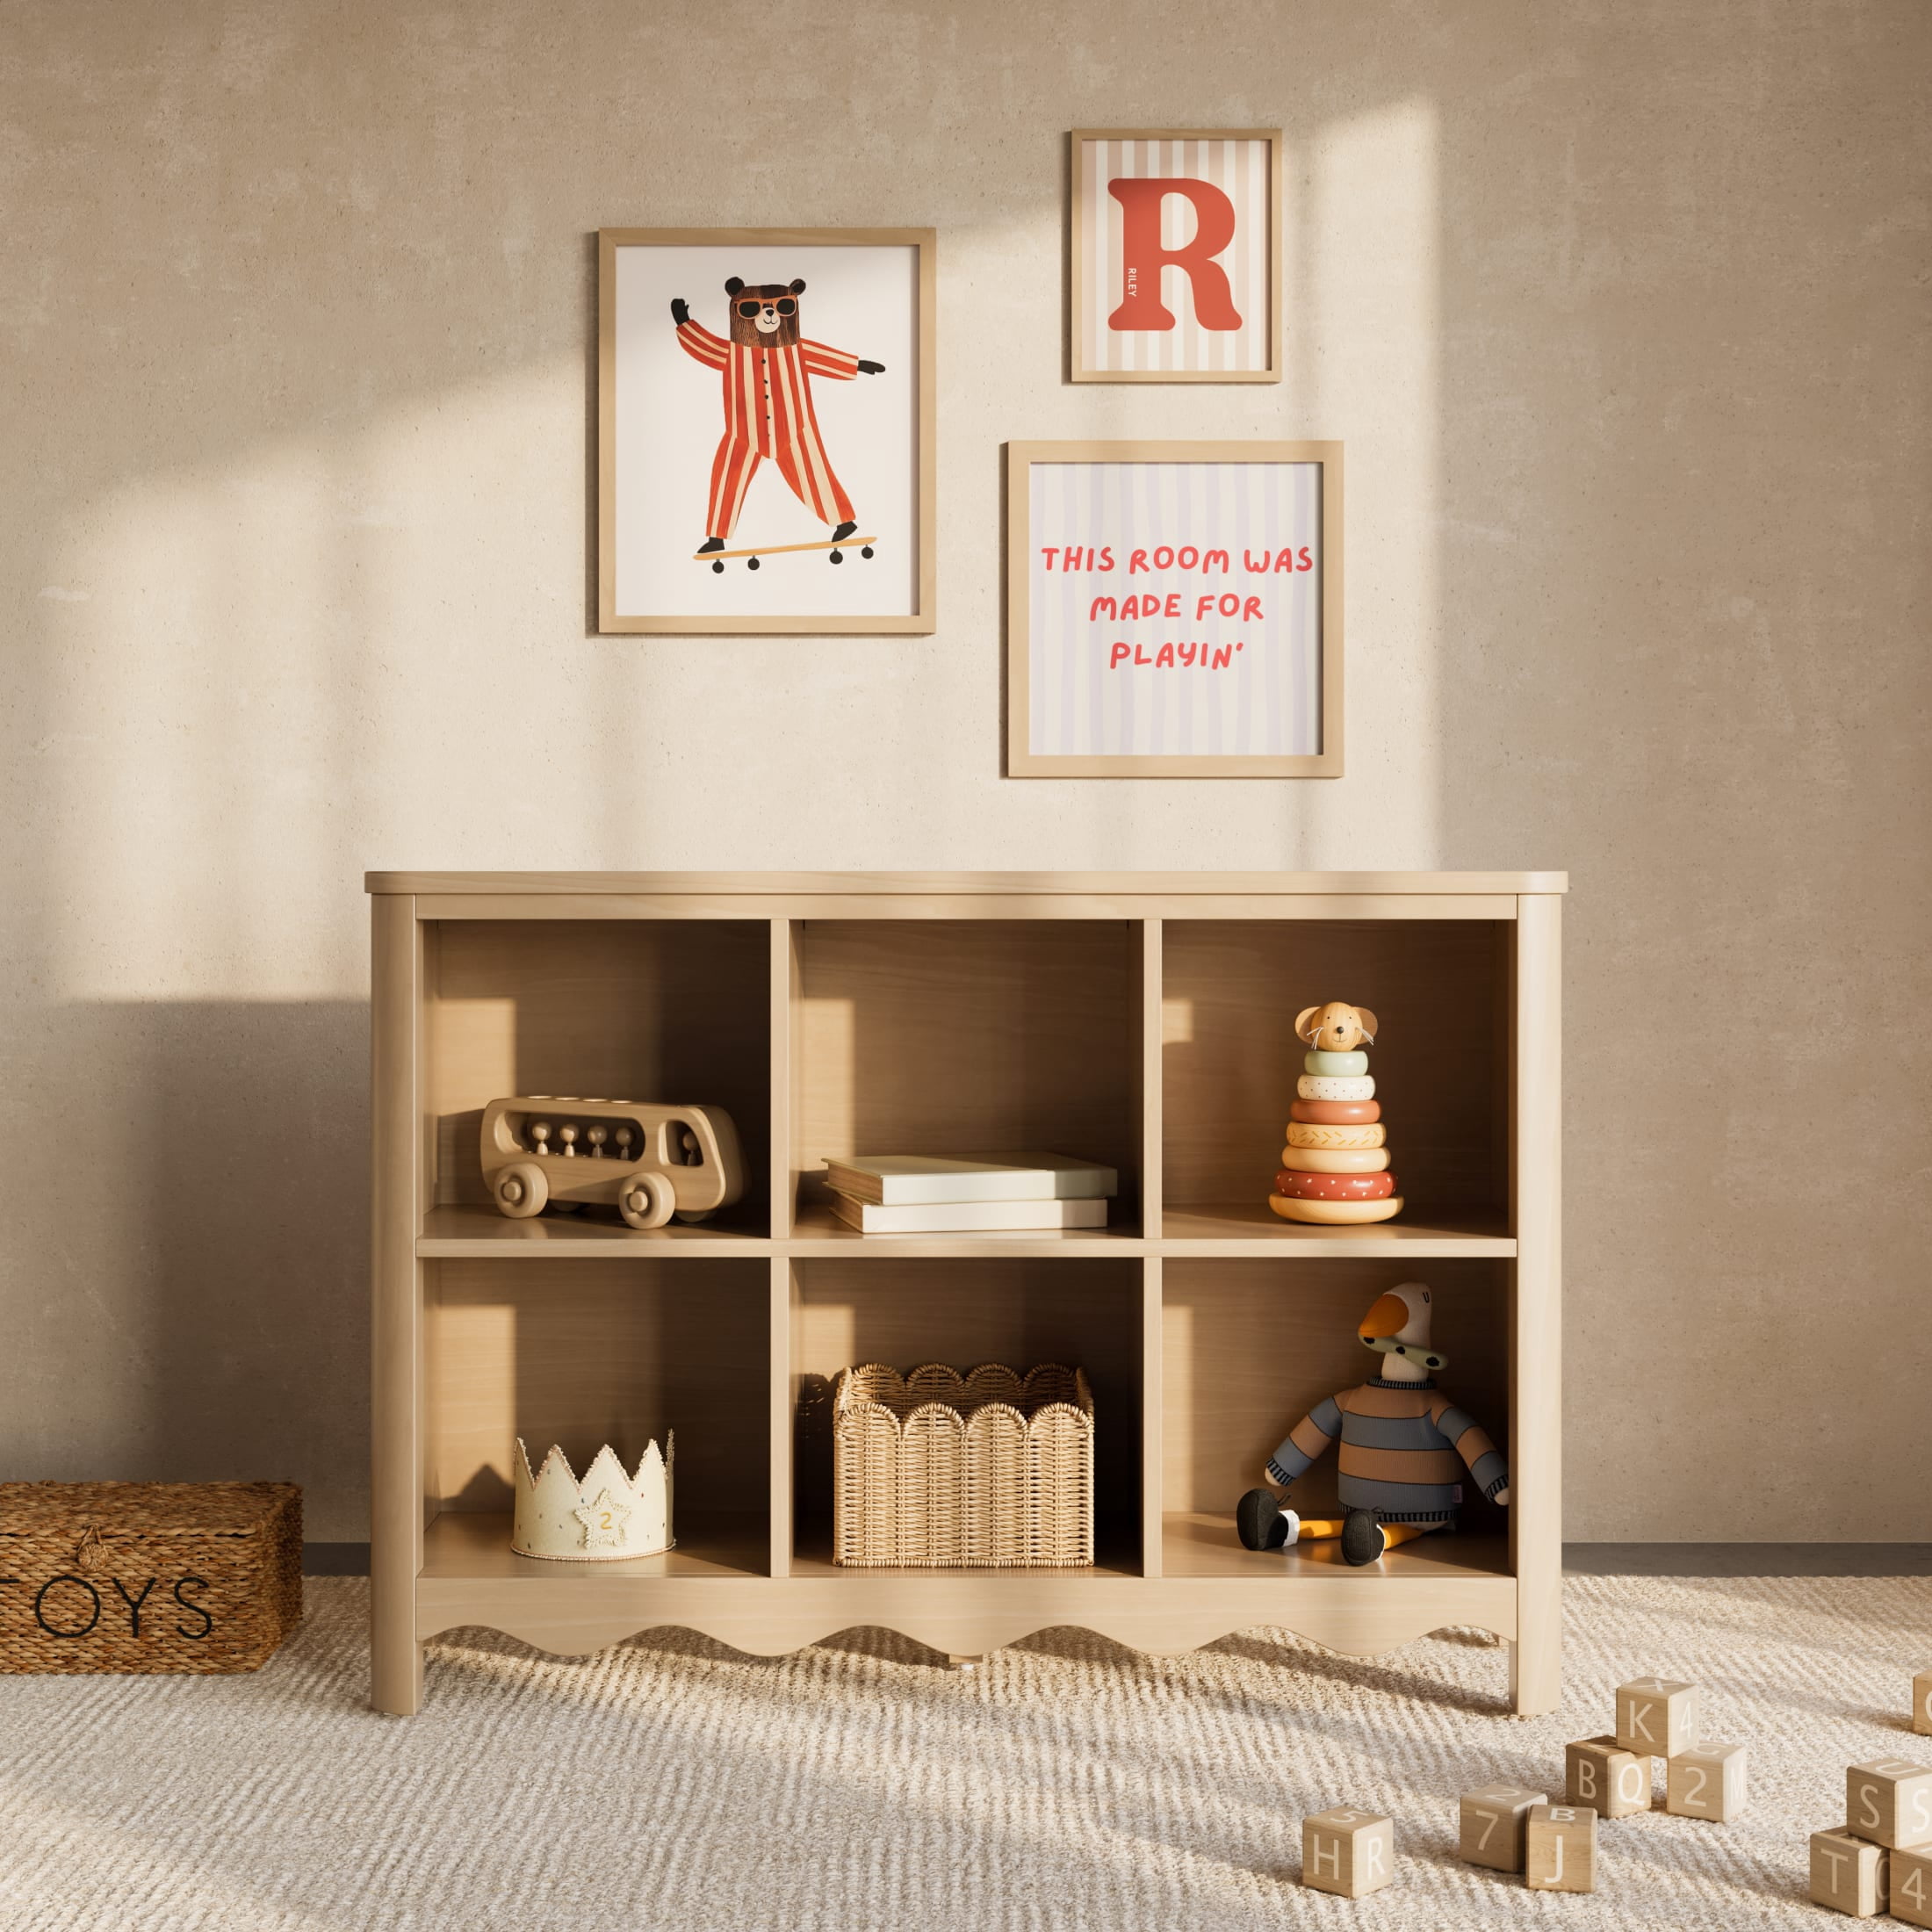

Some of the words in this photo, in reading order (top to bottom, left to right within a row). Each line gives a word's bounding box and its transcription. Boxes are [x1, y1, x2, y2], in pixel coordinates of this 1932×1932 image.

[1107, 177, 1243, 331] R
[1128, 267, 1137, 298] RILEY
[1042, 546, 1114, 573] THIS
[1129, 546, 1229, 574] ROOM
[1244, 546, 1313, 573] WAS
[1090, 594, 1181, 621] MADE
[1196, 593, 1264, 622] FOR
[1110, 642, 1244, 670] PLAYIN'
[600, 1511, 613, 1530] 2
[1637, 1678, 1681, 1692] X
[1629, 1700, 1655, 1743] K
[1679, 1701, 1693, 1740] 4
[1486, 1788, 1521, 1801] 2
[1578, 1758, 1597, 1799] B
[1618, 1763, 1646, 1806] Q
[1684, 1766, 1707, 1807] 2
[1550, 1807, 1576, 1821] B
[1859, 1784, 1881, 1829] S
[1912, 1788, 1930, 1834] S
[1475, 1809, 1499, 1851] 7
[1313, 1834, 1340, 1881] H
[1367, 1836, 1387, 1881] R
[1545, 1835, 1564, 1884] J
[1820, 1848, 1849, 1895] T
[1900, 1867, 1927, 1912] 4
